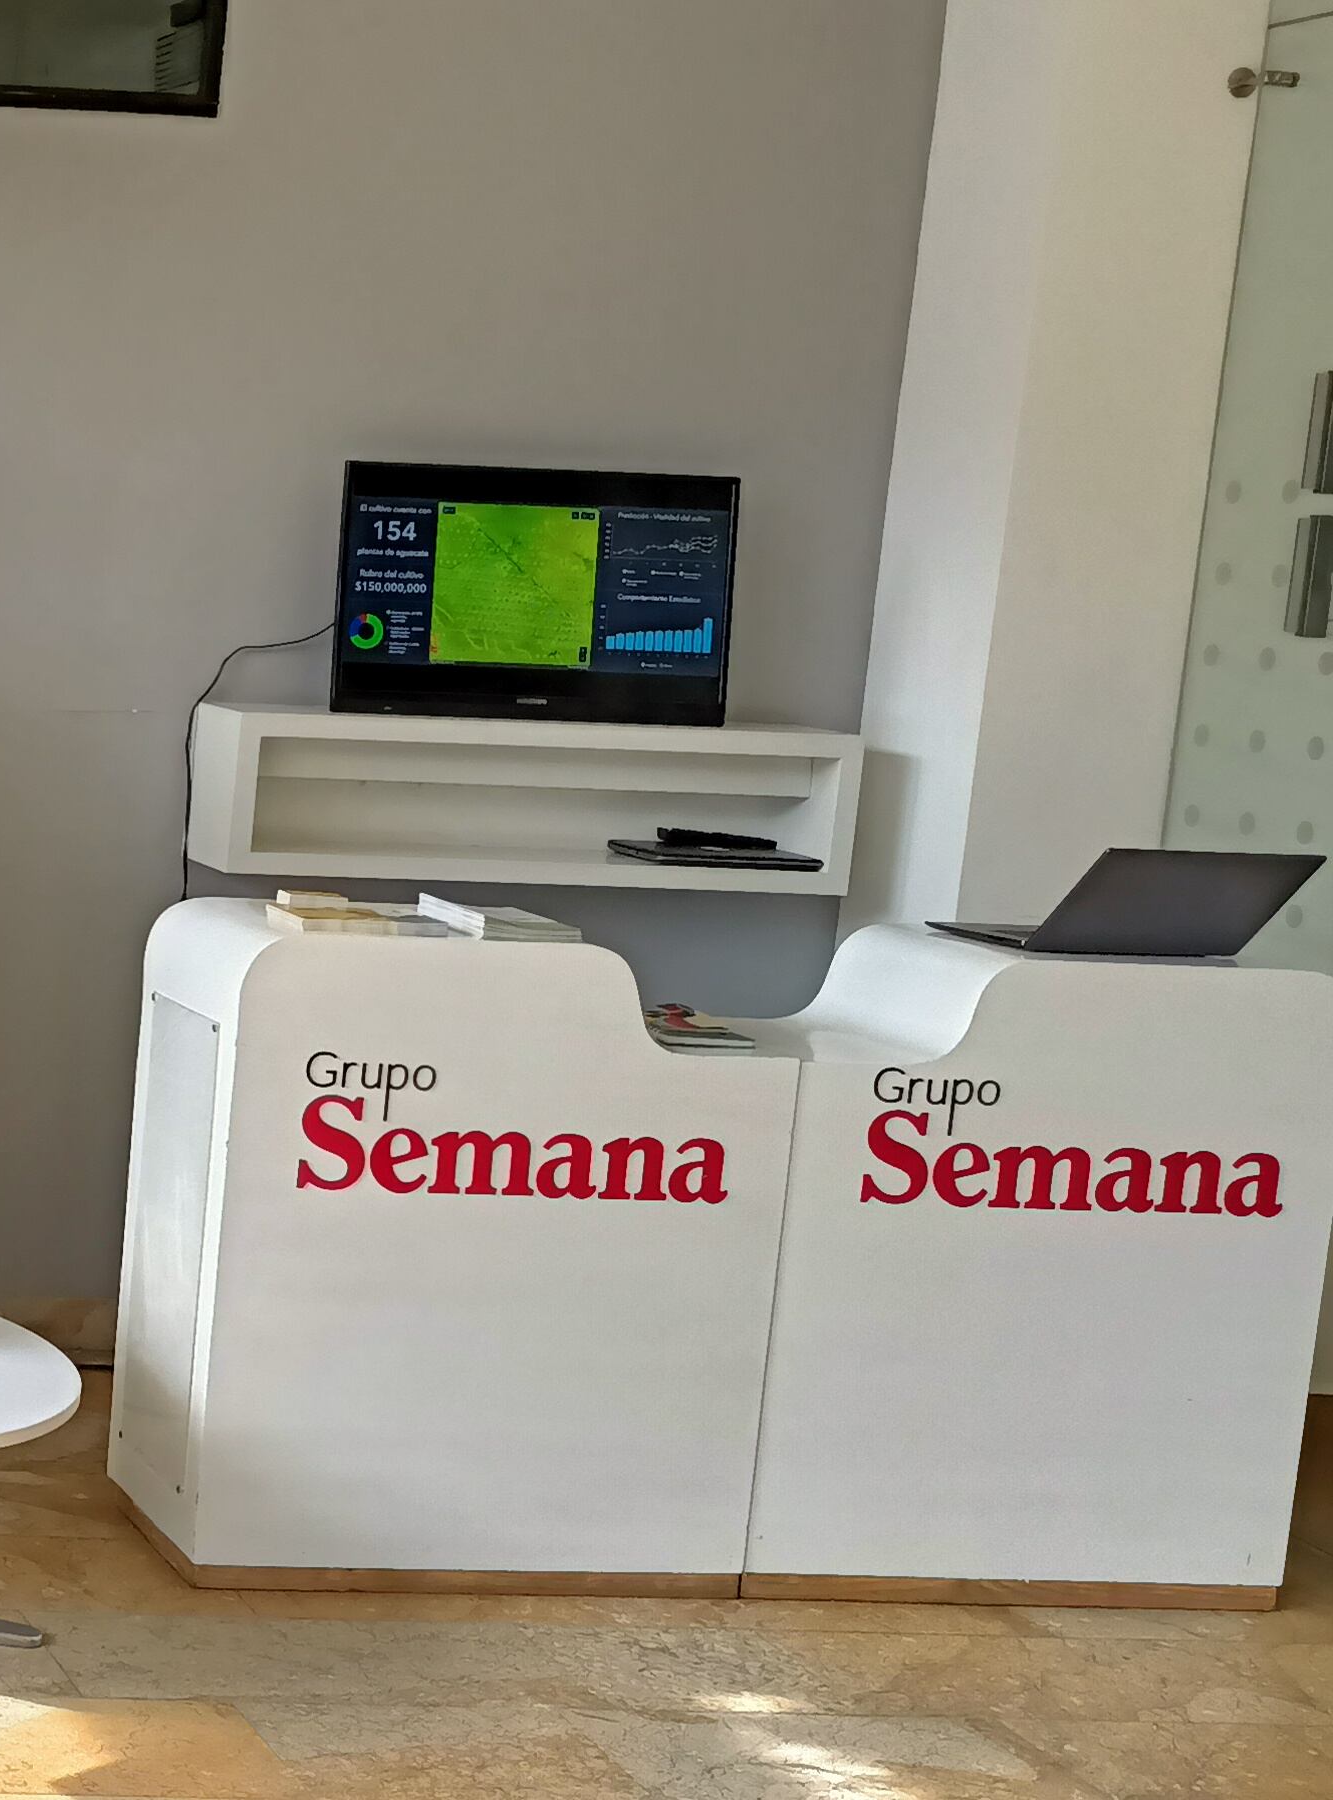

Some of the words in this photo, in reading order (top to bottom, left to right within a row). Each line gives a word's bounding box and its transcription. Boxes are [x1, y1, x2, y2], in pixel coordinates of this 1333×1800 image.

[373, 520, 417, 541] 154
[354, 581, 427, 594] $150,000,000
[305, 1051, 437, 1121] Grupo
[873, 1067, 1001, 1136] Grupo
[296, 1094, 729, 1204] Semana
[860, 1110, 1283, 1218] Semana
